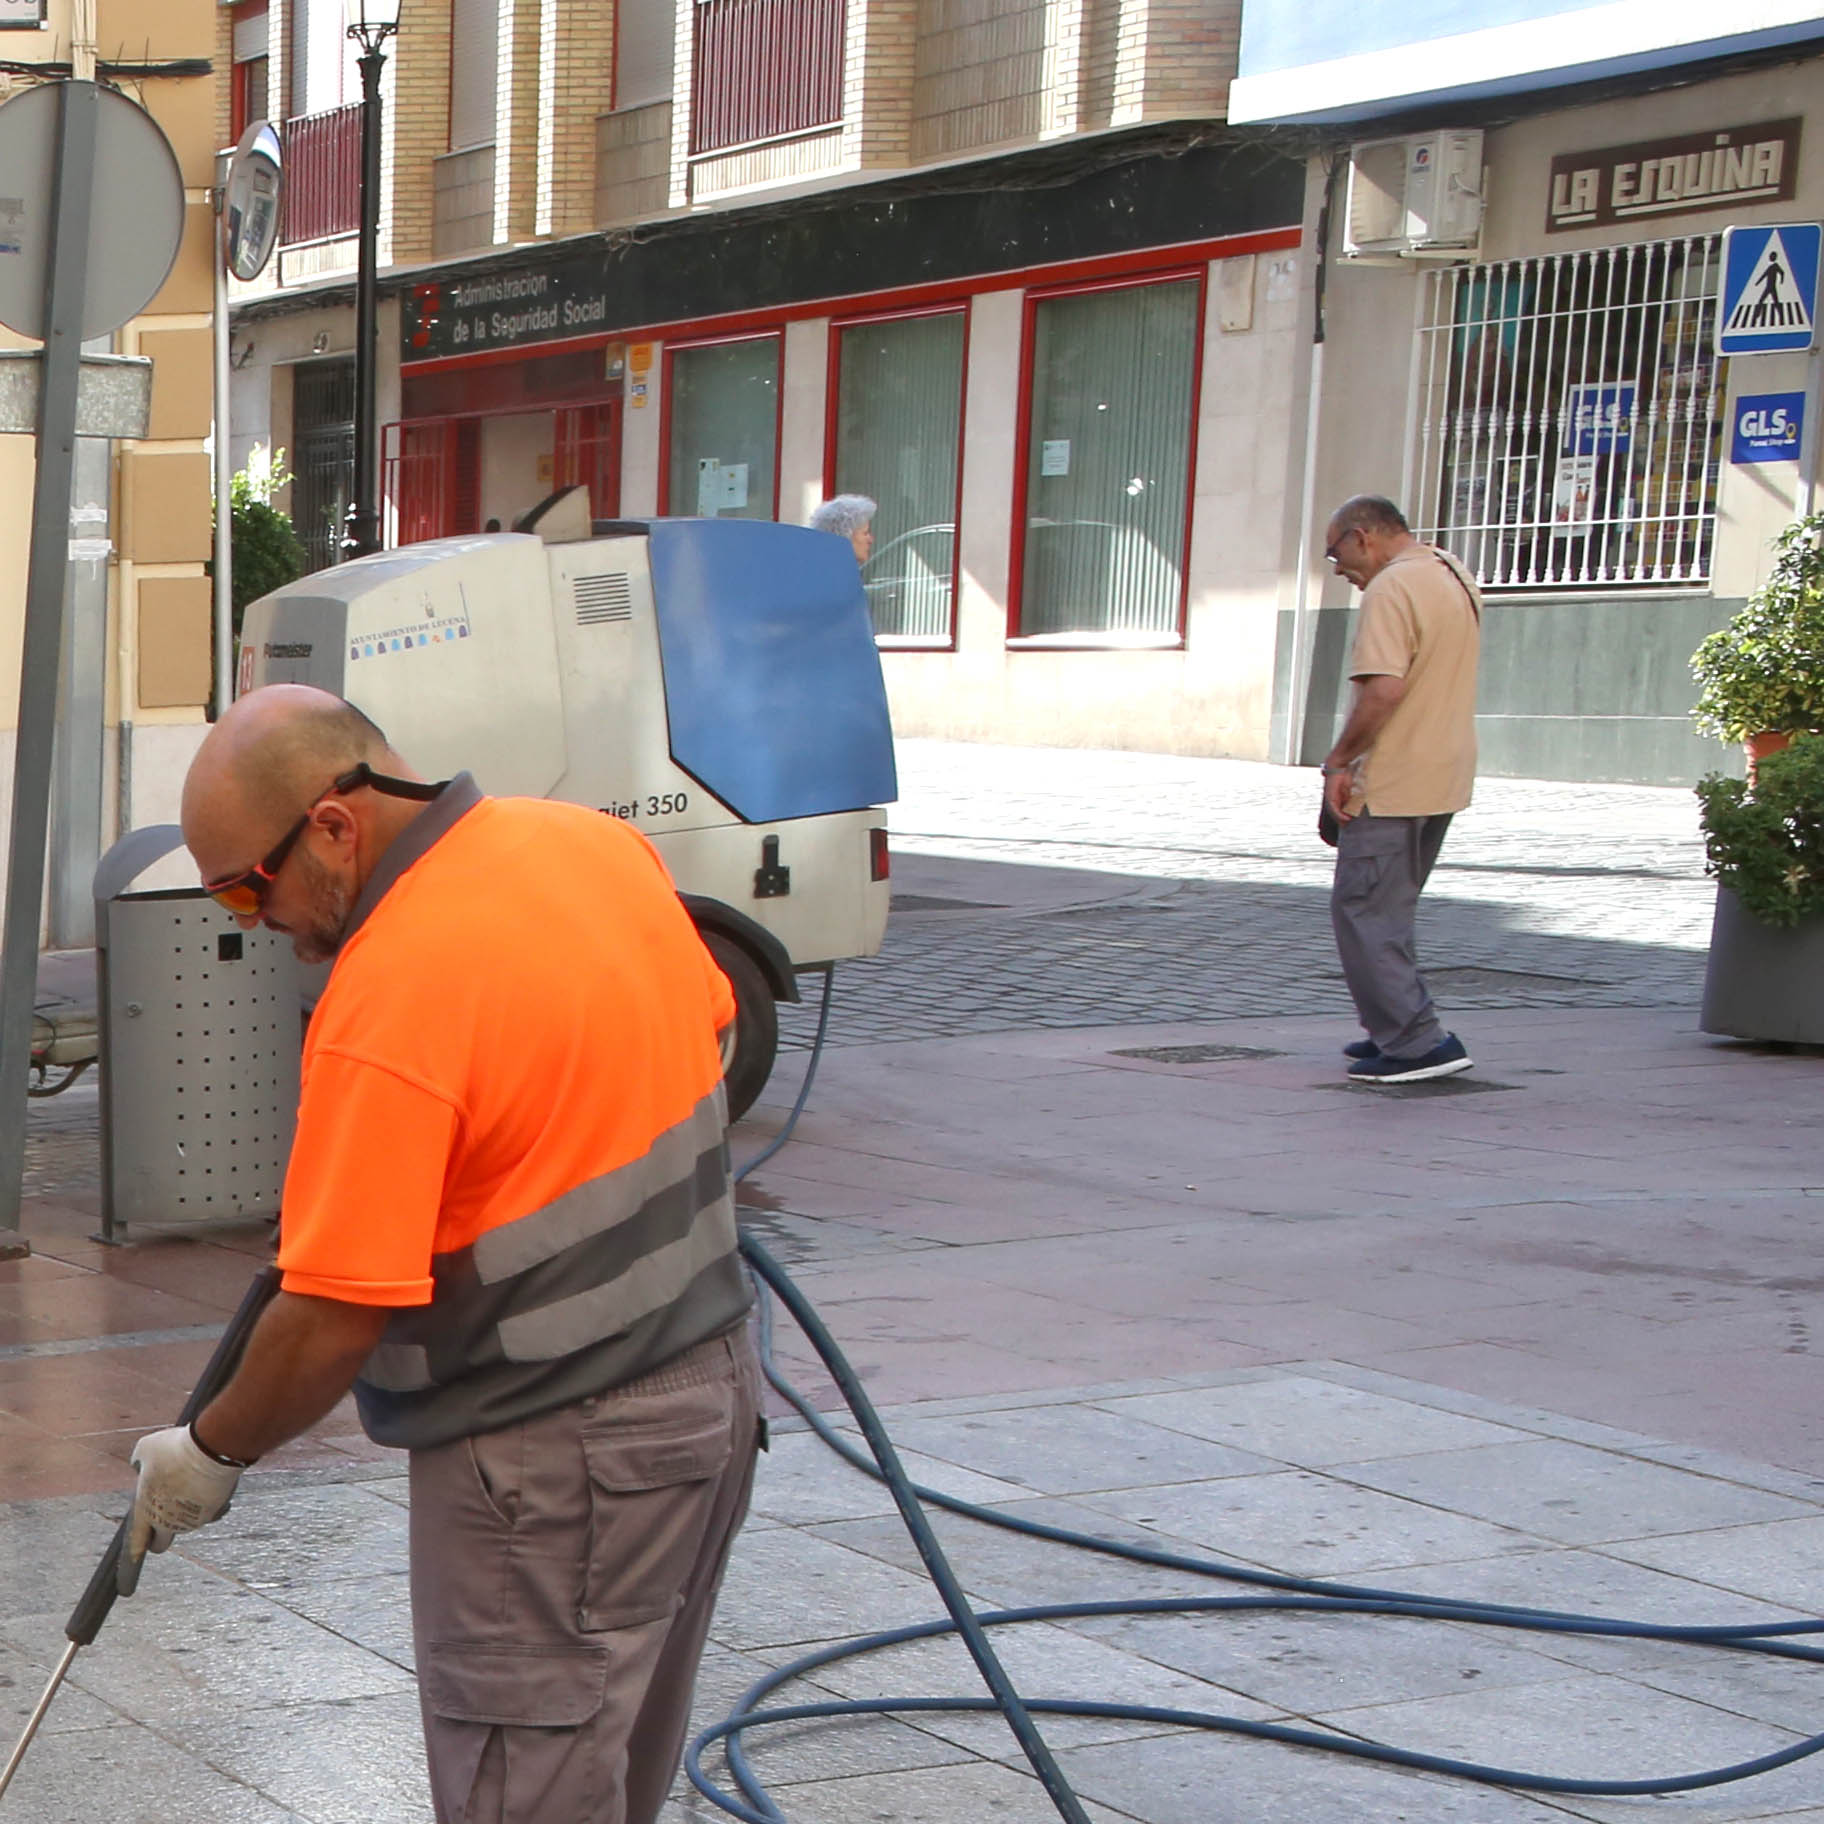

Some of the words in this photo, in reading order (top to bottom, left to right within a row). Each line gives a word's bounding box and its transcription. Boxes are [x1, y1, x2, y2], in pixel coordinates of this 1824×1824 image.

[1552, 169, 1600, 216] LA
[1611, 134, 1784, 207] ESQUINA
[453, 318, 469, 342] de
[474, 316, 486, 339] la
[492, 305, 558, 340] Seguridad
[564, 296, 606, 325] Social
[1739, 408, 1787, 438] GLS
[646, 792, 689, 817] 350
